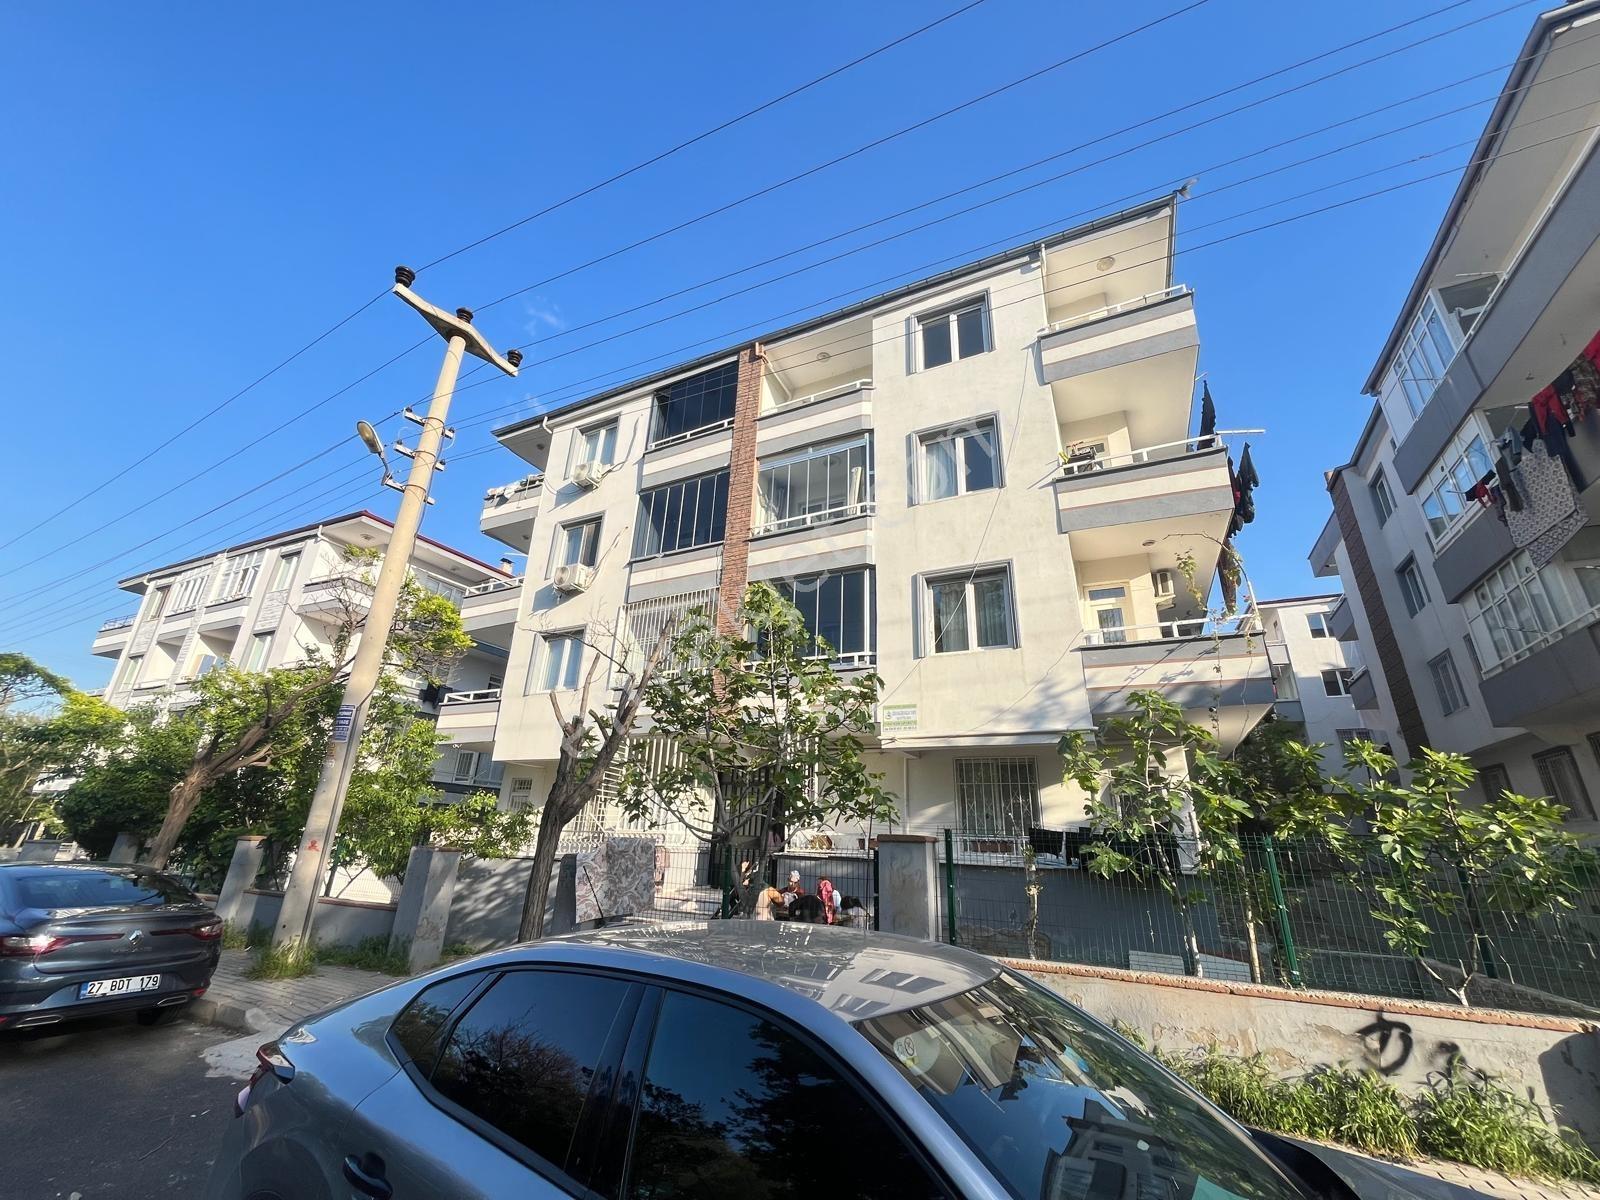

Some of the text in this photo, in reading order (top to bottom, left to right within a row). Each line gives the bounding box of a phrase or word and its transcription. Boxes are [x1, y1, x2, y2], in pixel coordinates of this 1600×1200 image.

[88, 976, 159, 994] 27 BDT 179
